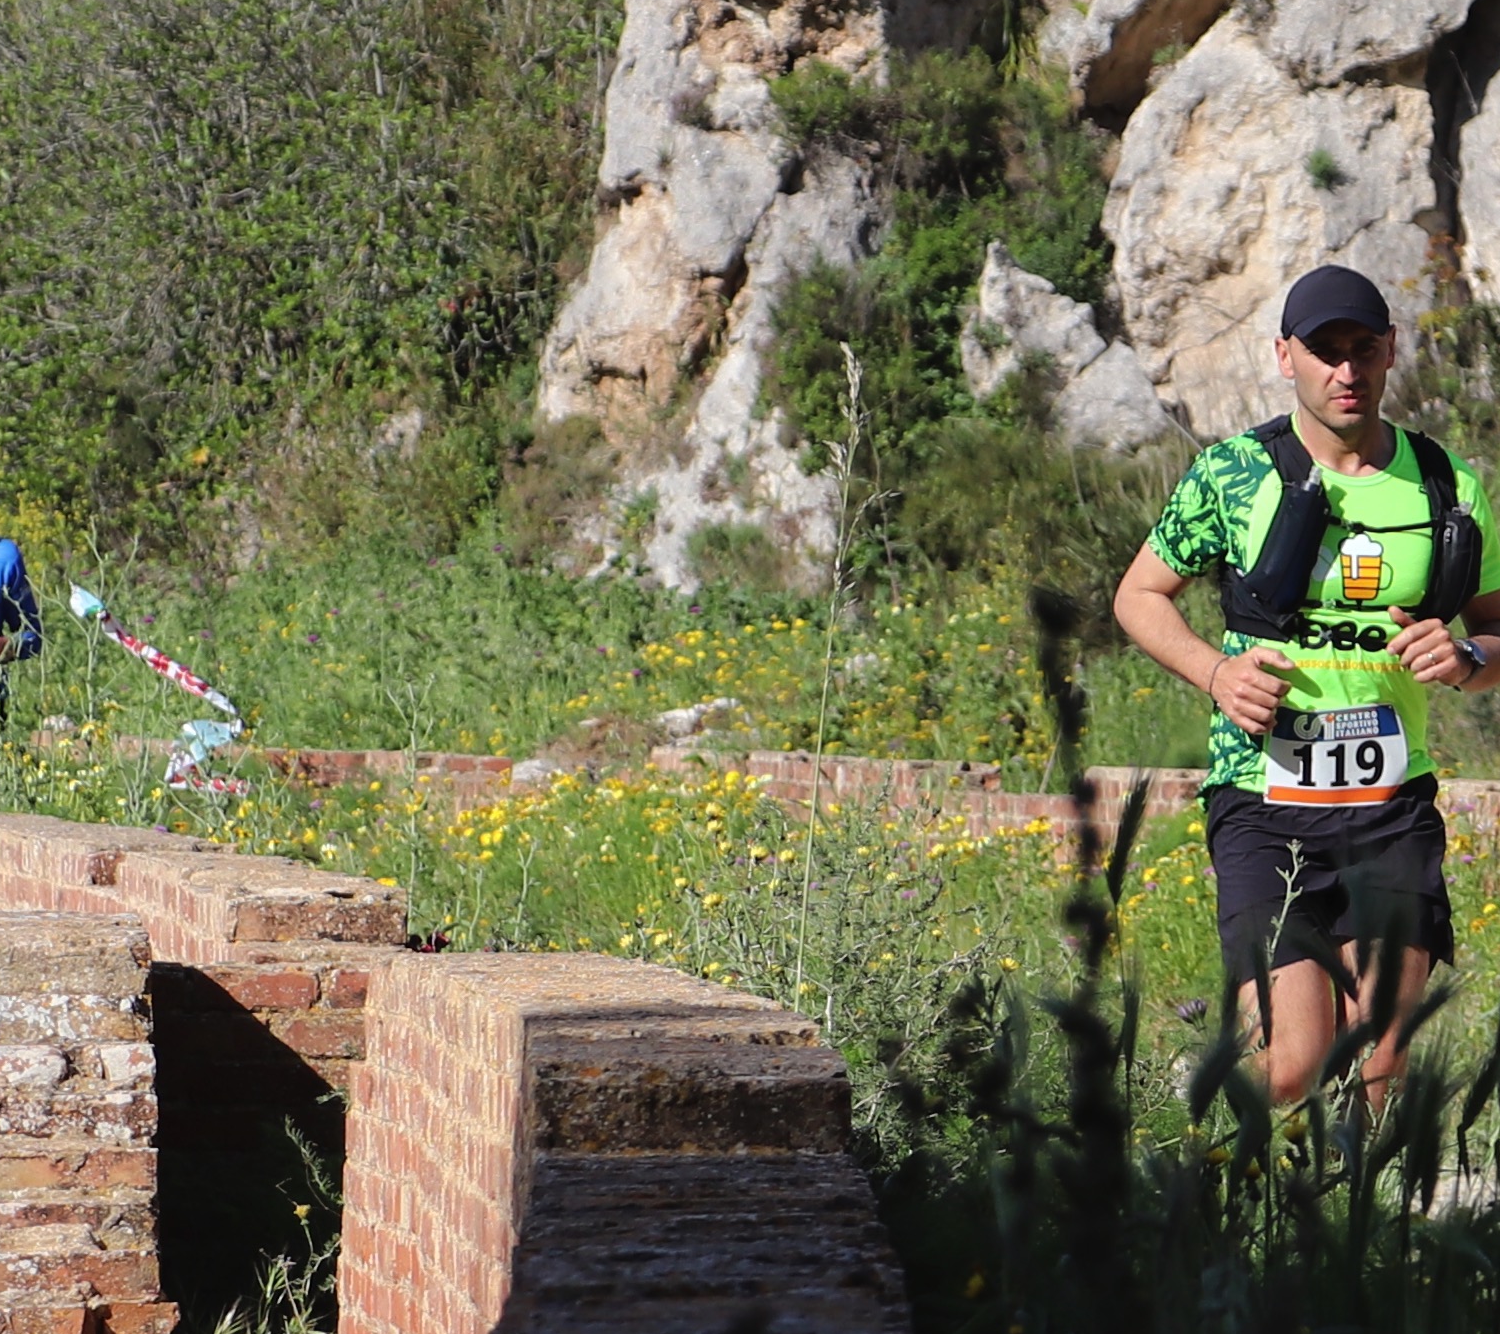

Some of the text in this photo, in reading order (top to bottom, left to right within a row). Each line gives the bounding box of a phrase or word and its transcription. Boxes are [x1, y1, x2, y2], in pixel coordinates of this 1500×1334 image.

[1335, 710, 1378, 721] CENTRO
[1335, 718, 1379, 730] SPORTIVO
[1335, 727, 1380, 737] ITALIANO
[1293, 740, 1385, 788] 119
